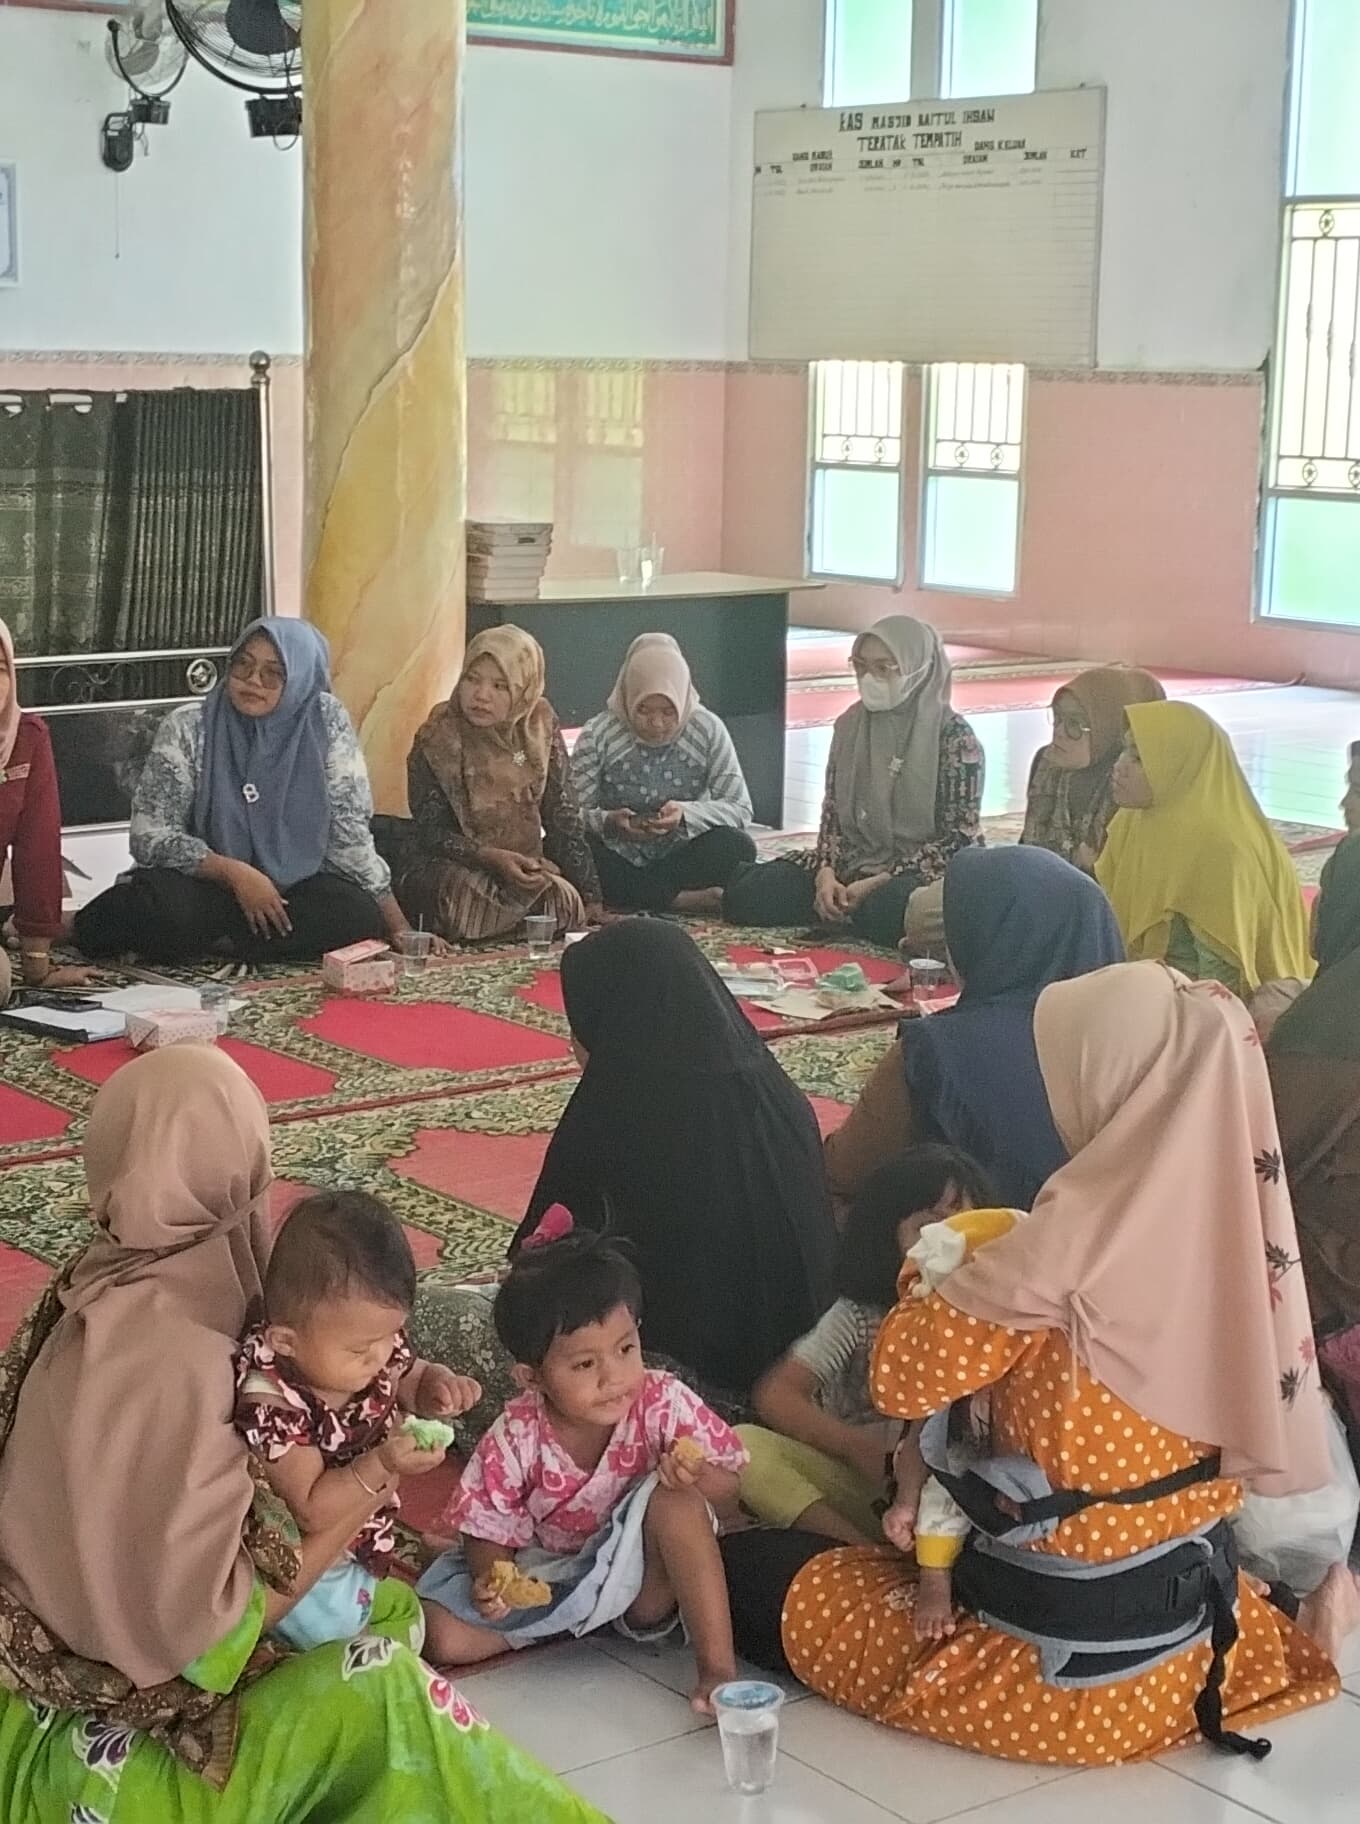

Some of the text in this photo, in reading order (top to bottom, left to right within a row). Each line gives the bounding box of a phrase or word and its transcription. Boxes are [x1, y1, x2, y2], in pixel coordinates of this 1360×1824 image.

[839, 109, 995, 132] KAS MASJID BAITUL IHSAN
[857, 131, 962, 152] TERATAK TEMPATIH
